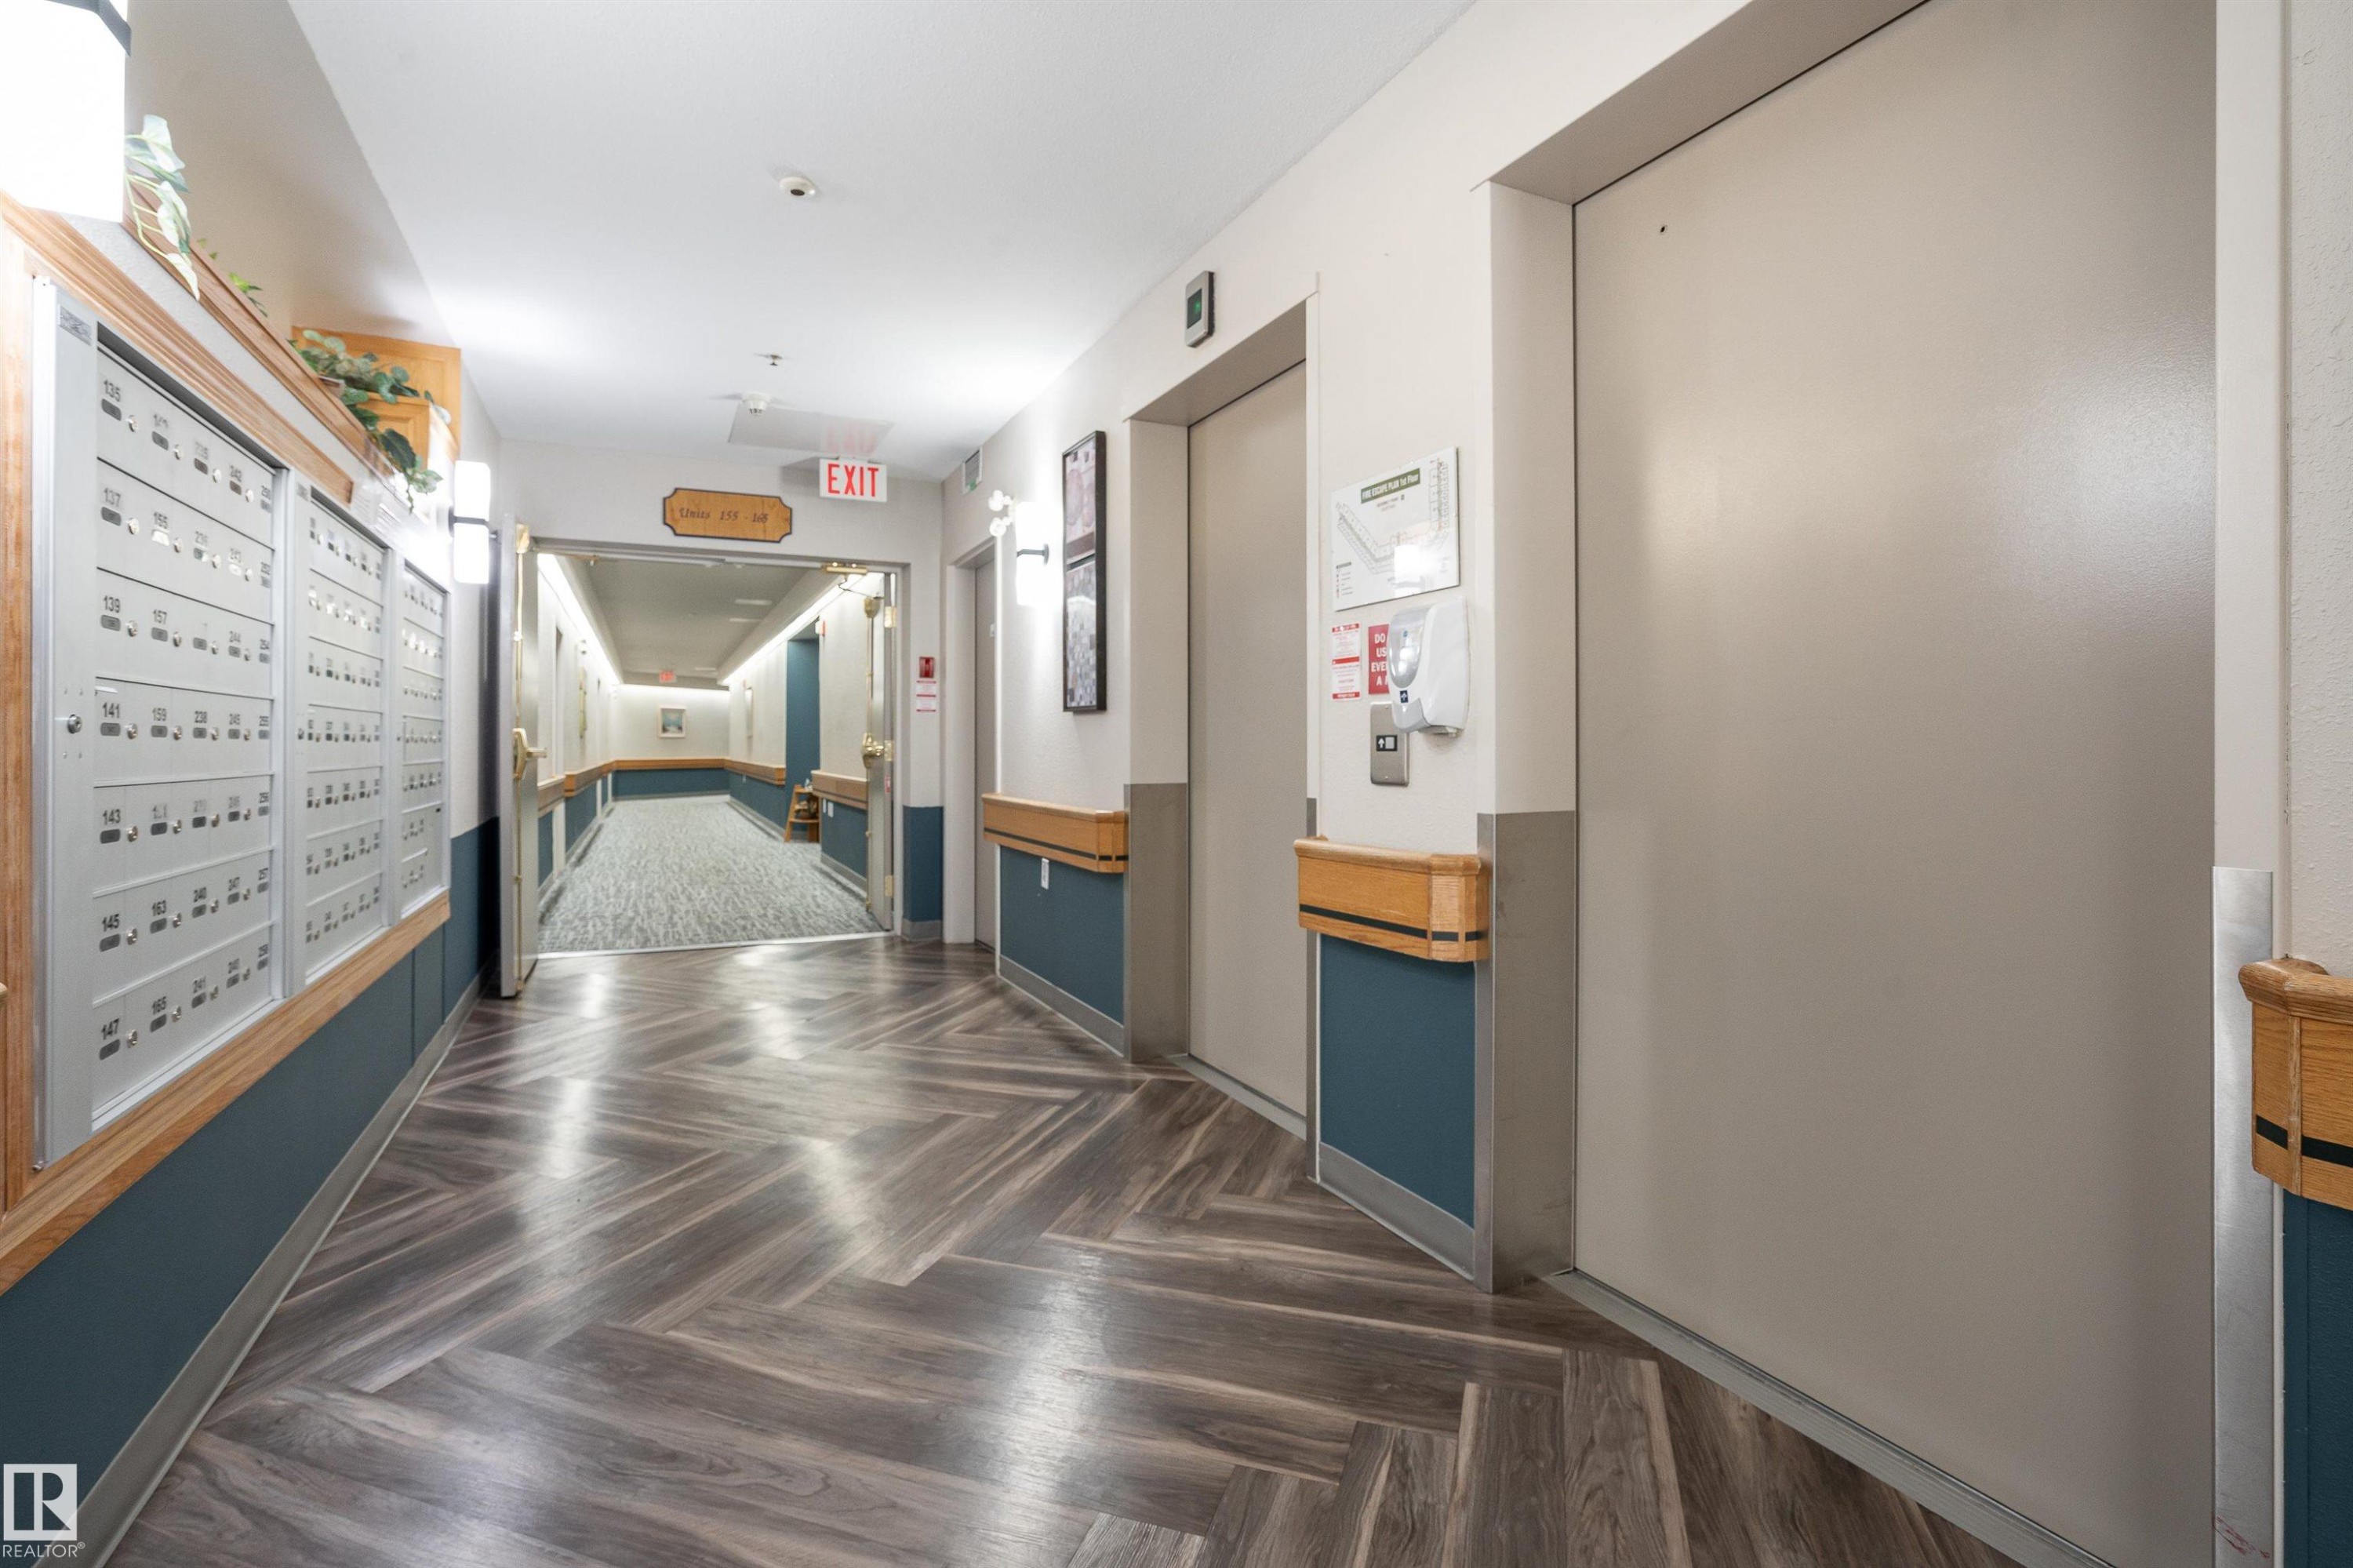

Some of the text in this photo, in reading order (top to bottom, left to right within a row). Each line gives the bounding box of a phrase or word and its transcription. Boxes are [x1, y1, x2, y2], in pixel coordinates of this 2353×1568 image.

[103, 380, 121, 402] 135
[827, 463, 878, 497] EXIT
[103, 487, 121, 508] 137
[679, 507, 711, 520] Units
[719, 510, 739, 522] 155
[103, 595, 121, 613] 139
[153, 609, 167, 625] 157
[1374, 633, 1386, 644] DO
[1376, 647, 1387, 657] US
[1371, 661, 1387, 672] EVE
[1376, 675, 1383, 686] A
[102, 702, 120, 719] 141
[152, 708, 167, 722] 159
[102, 809, 121, 825] 143
[152, 899, 167, 917] 163
[102, 913, 120, 932] 145
[152, 995, 167, 1015] 165
[101, 1017, 120, 1041] 147
